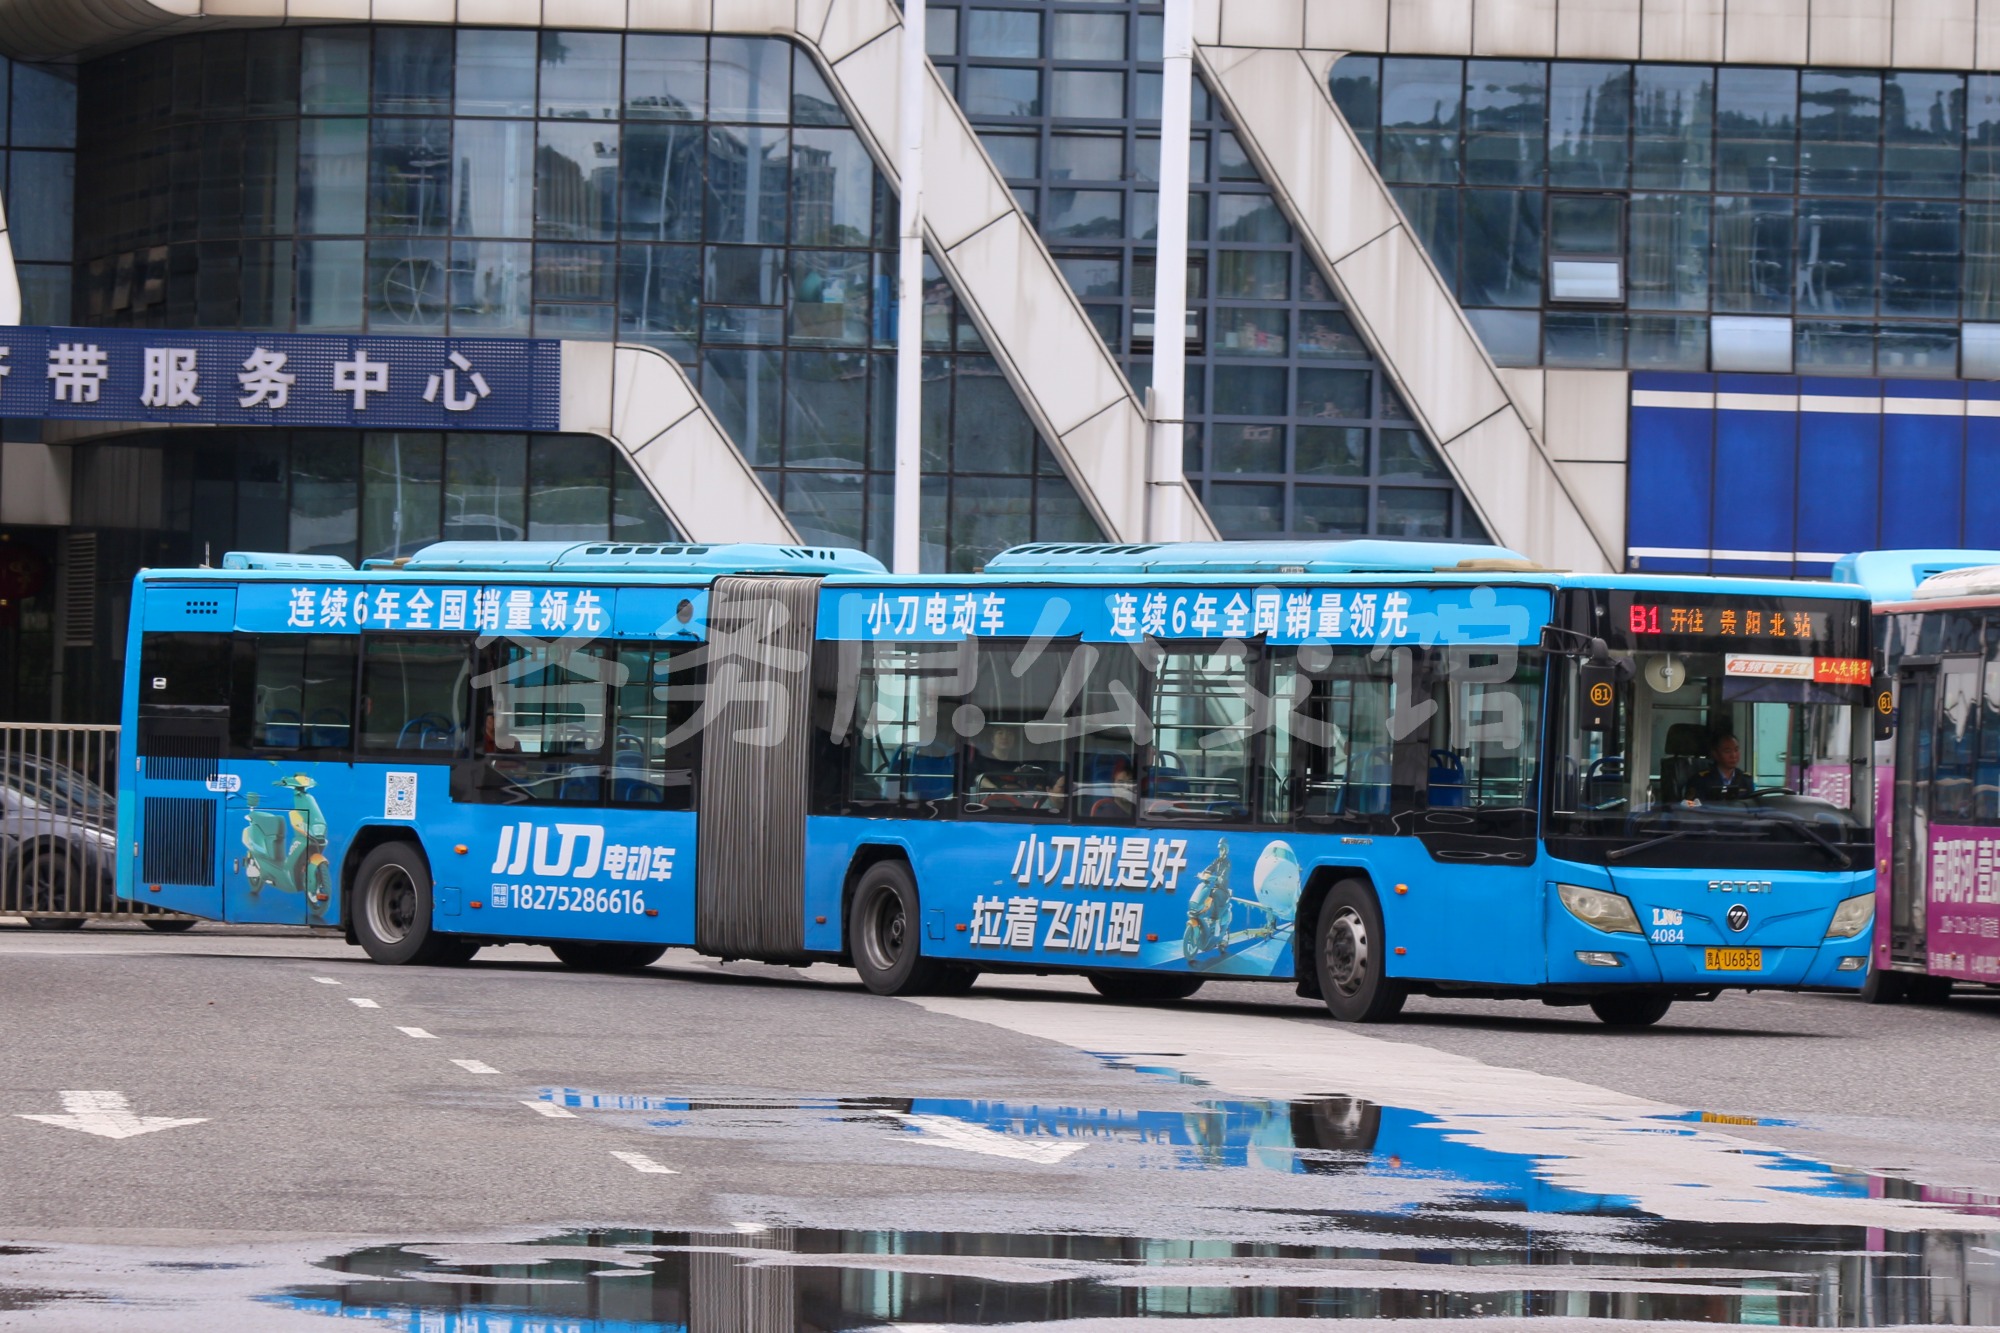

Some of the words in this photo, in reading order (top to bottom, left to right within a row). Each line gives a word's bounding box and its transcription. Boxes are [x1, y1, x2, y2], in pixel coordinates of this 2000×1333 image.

[287, 587, 602, 632] 连续6年全国销量领先
[867, 592, 1006, 637] 小刀电动车
[1109, 590, 1409, 639] 连续6年全国销量领先
[1629, 605, 1661, 634] B1
[1670, 608, 1704, 633] 开往
[1818, 661, 1868, 681] 工人先锋号
[1594, 688, 1609, 701] B1
[1881, 697, 1893, 709] B1
[1011, 834, 1188, 890] 小刀就是好
[510, 884, 645, 915] 18275286616
[1707, 880, 1772, 893] FOTON
[970, 896, 1144, 953] 拉着飞机跑
[1652, 908, 1683, 926] LNG
[1651, 929, 1685, 943] 4084
